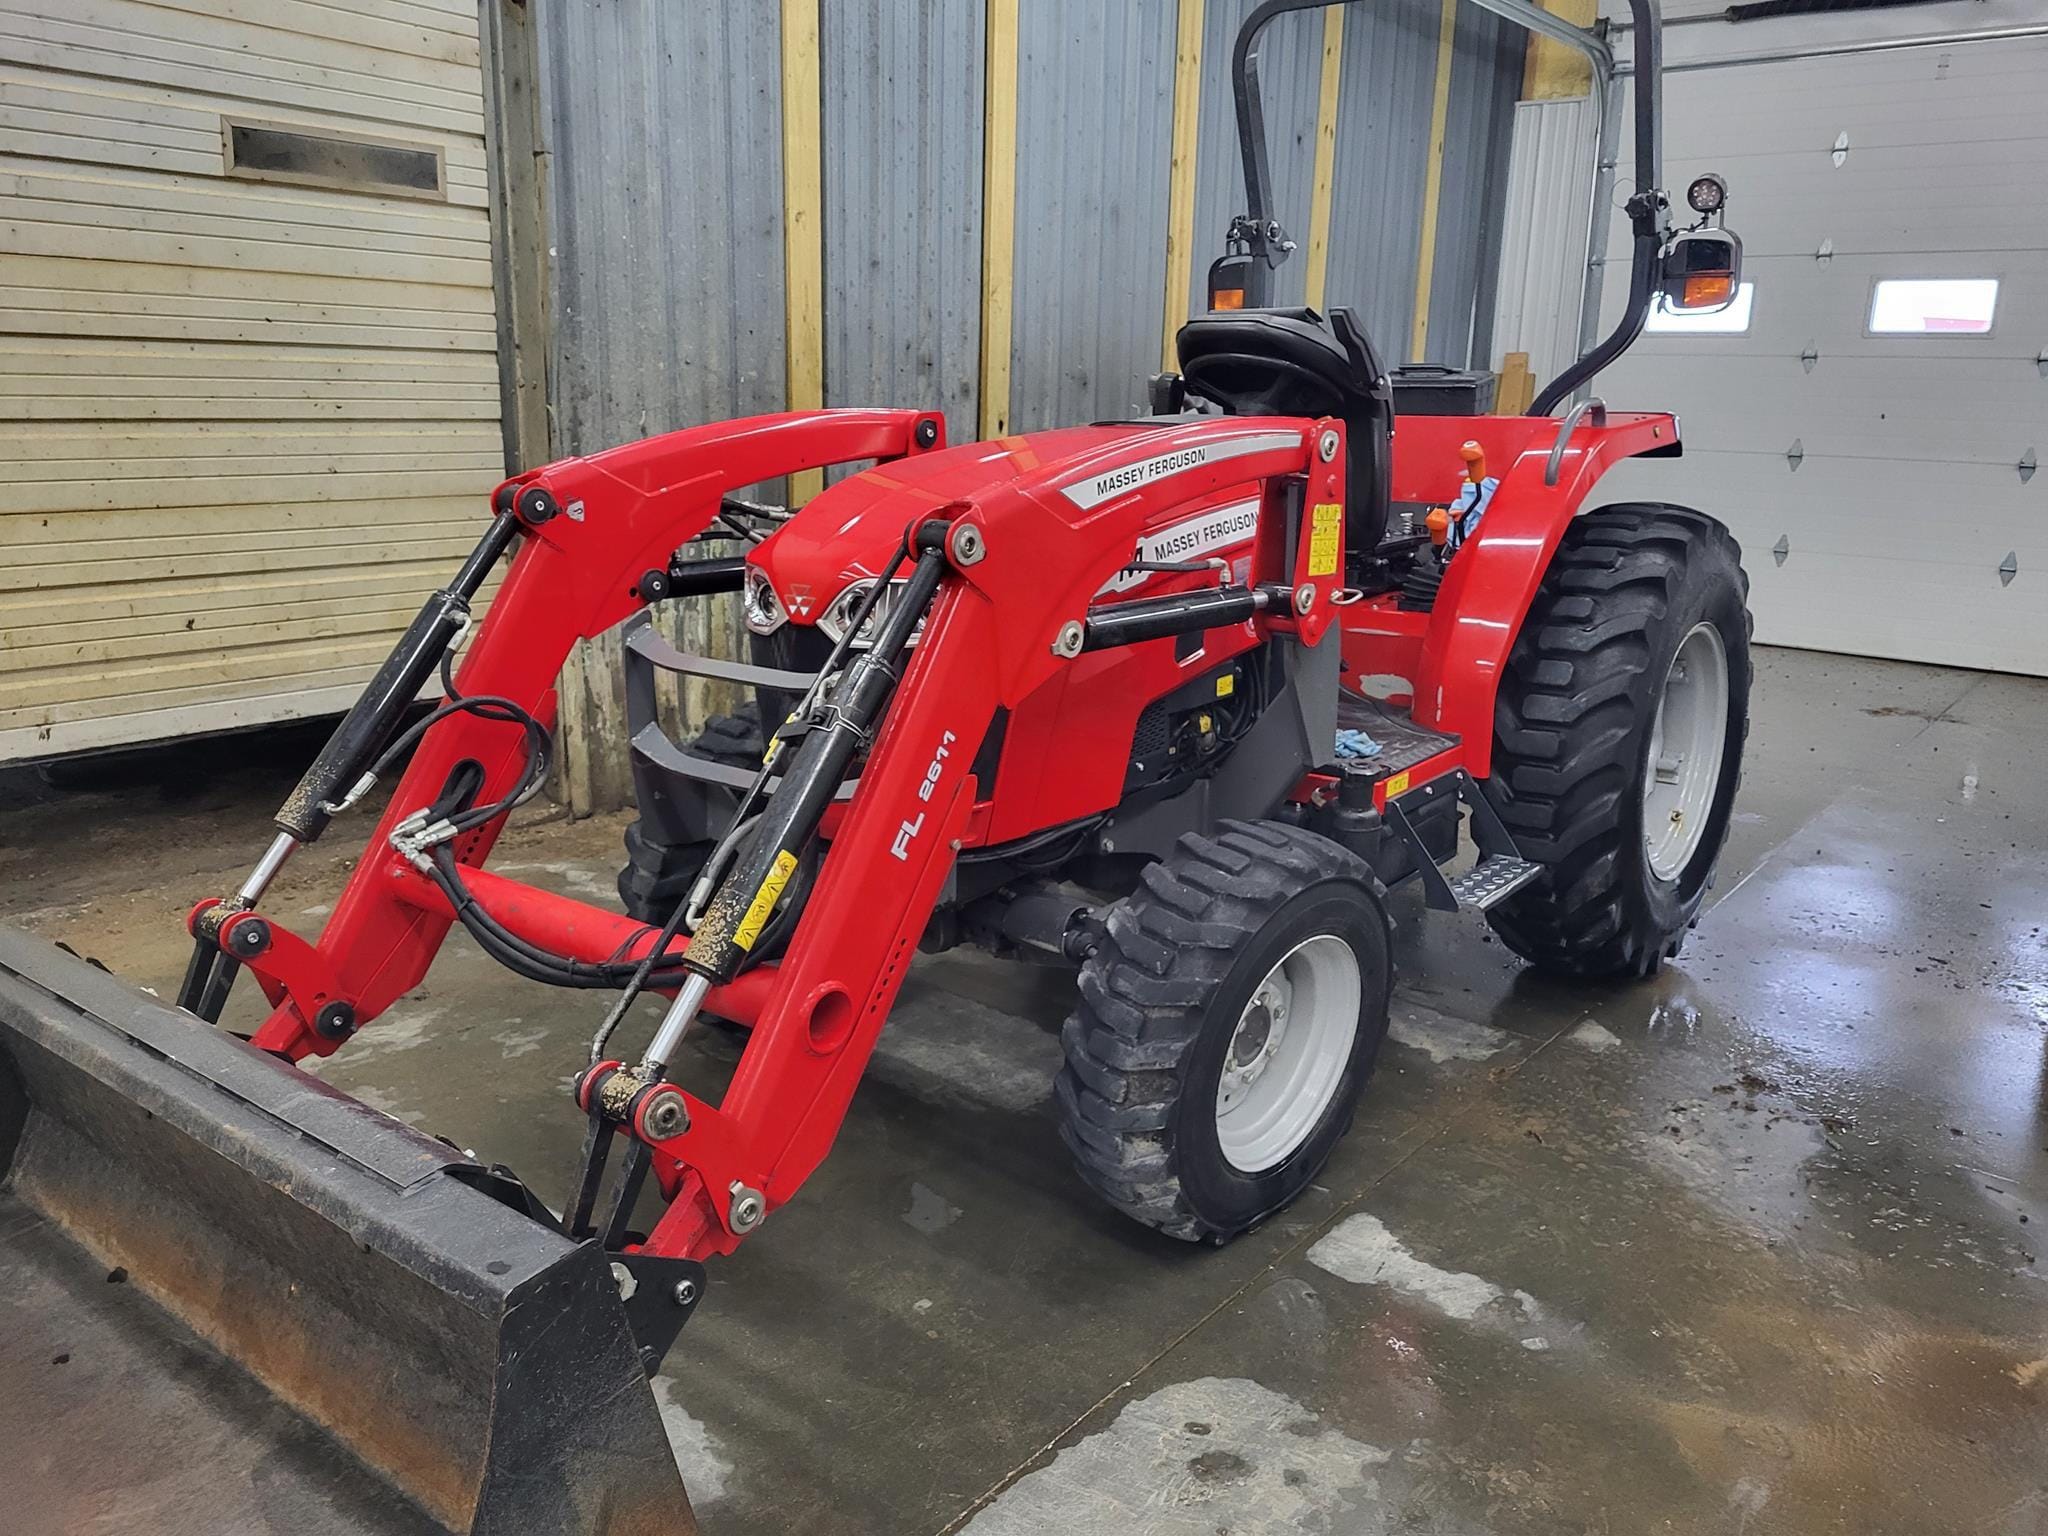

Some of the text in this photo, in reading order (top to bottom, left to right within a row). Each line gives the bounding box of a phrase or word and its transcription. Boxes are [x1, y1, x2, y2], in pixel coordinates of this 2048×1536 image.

[1097, 448, 1206, 496] MASSEY FERGUSON
[1154, 511, 1259, 561] MASSEY FERGUSON
[890, 730, 956, 862] FL 2611
